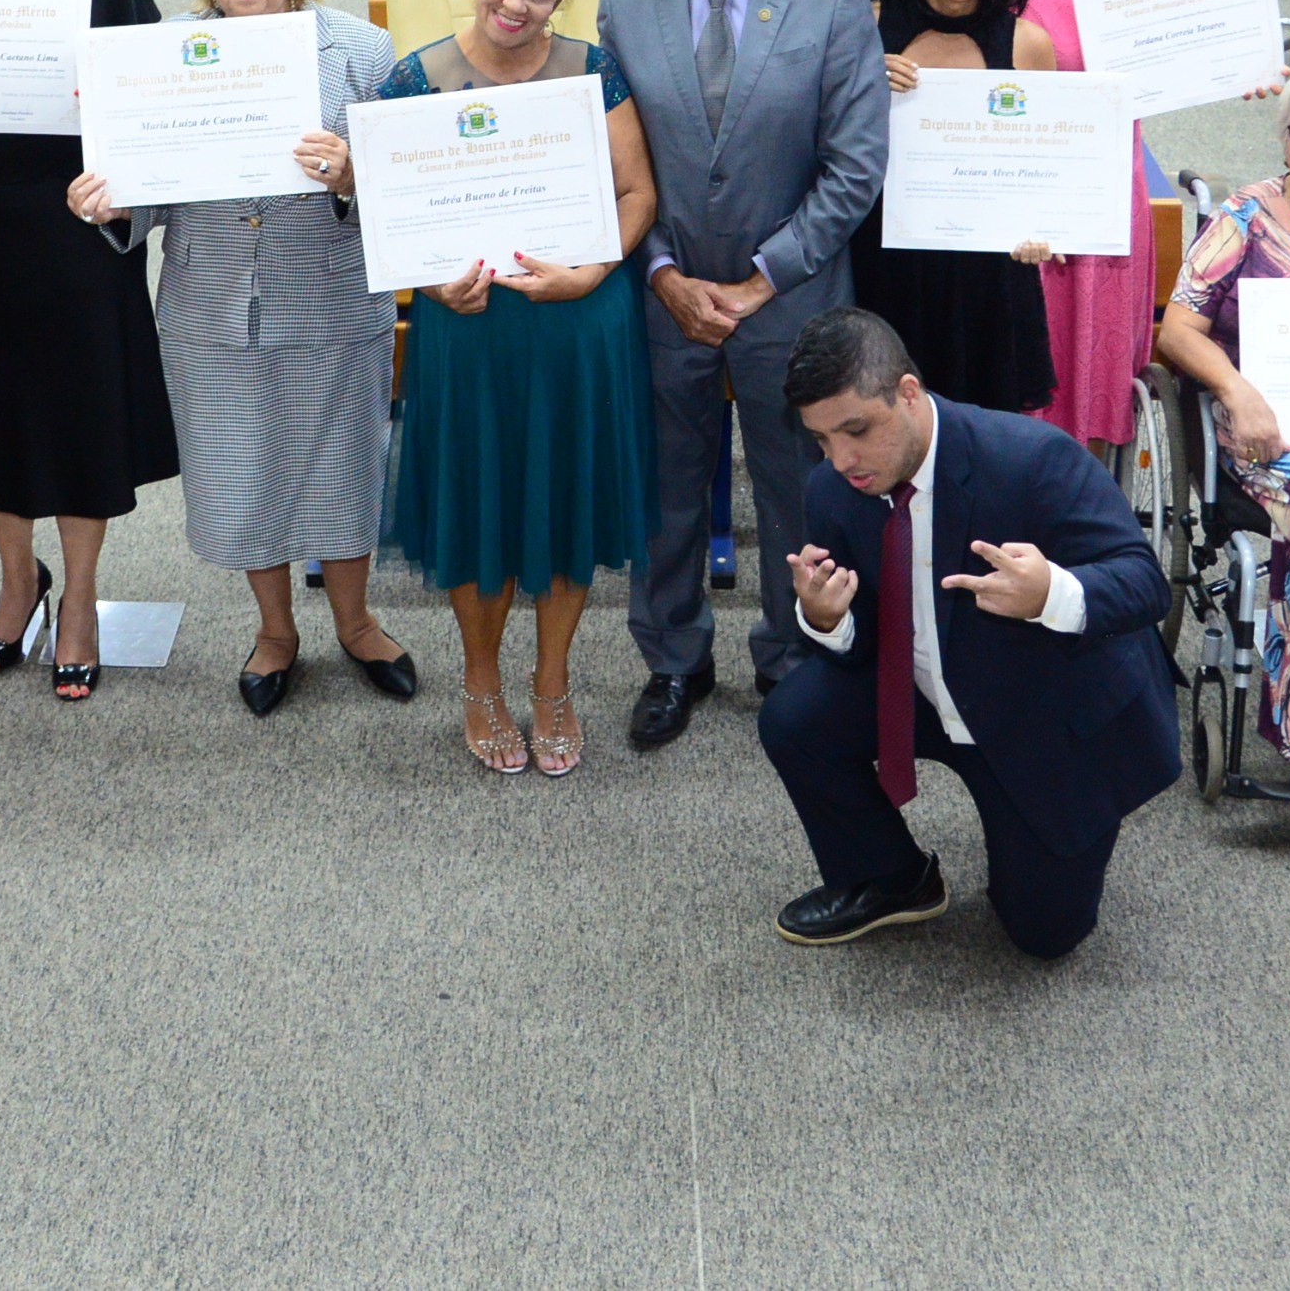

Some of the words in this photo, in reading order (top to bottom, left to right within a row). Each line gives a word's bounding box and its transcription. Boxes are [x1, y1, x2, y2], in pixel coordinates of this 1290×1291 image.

[0, 8, 13, 17] ao
[16, 6, 57, 18] Mérito
[0, 53, 35, 61] Caetano
[36, 54, 59, 62] Lima
[115, 75, 168, 88] Diploma
[171, 73, 184, 83] de
[188, 70, 227, 82] Honra
[229, 69, 243, 79] ao
[247, 64, 286, 78] Mérito
[142, 121, 169, 131] Maria
[200, 118, 211, 126] de
[213, 116, 243, 125] Castro
[244, 113, 268, 123] Diniz
[920, 118, 971, 132] Diploma
[975, 121, 988, 131] de
[992, 119, 1031, 132] Honra
[1034, 123, 1049, 133] ao
[1052, 121, 1095, 134] Mérito
[390, 149, 444, 164] Diploma
[447, 146, 461, 157] de
[465, 141, 506, 155] Honra
[510, 139, 524, 149] ao
[528, 133, 571, 148] Mérito
[952, 167, 988, 176] Jaciara
[990, 168, 1015, 177] Alves
[1017, 168, 1059, 178] Pinheiro
[427, 194, 462, 207] Andréa
[465, 192, 496, 202] Bueno
[498, 188, 510, 198] de
[513, 185, 546, 196] Freitas
